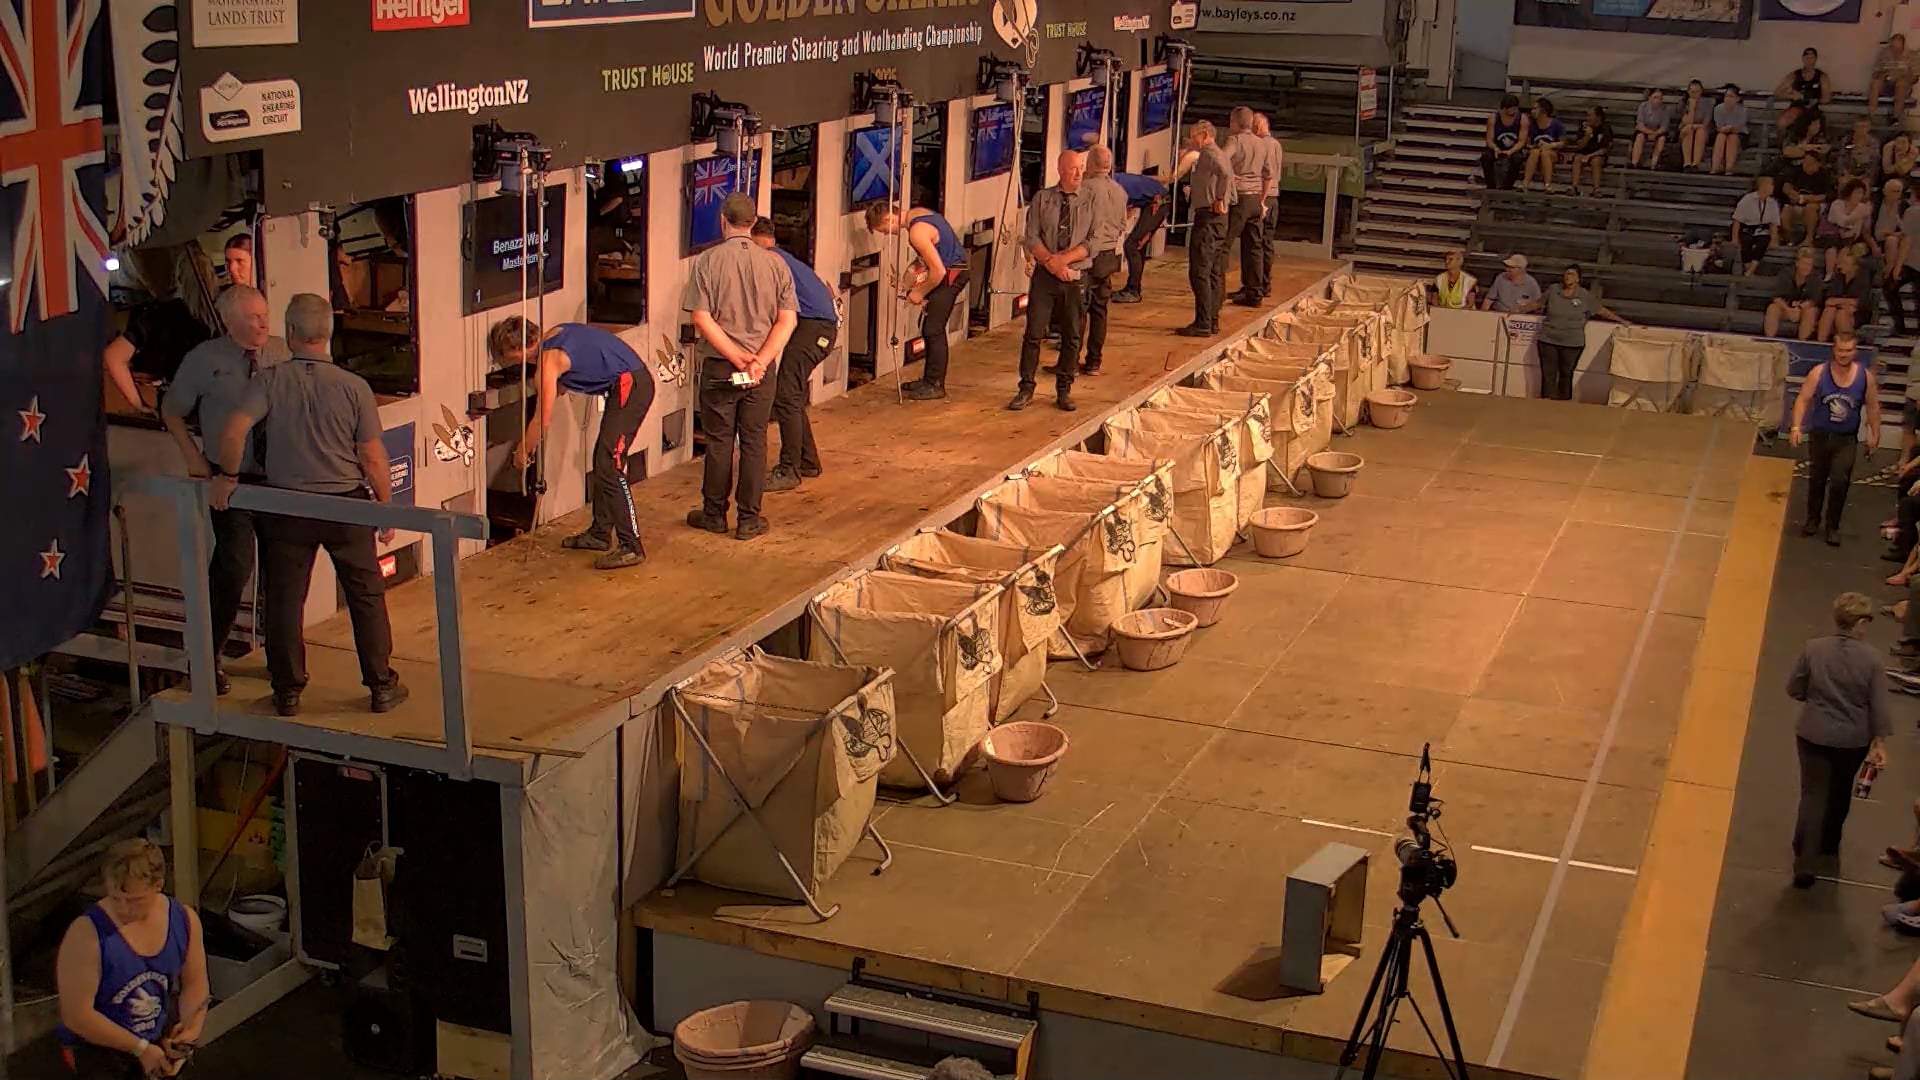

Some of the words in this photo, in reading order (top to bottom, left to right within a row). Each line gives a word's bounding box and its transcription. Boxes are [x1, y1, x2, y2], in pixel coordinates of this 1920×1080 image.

[208, 11, 247, 26] LANDS
[250, 10, 286, 25] TRUST
[703, 43, 739, 72] World
[744, 40, 788, 68] Premier
[791, 35, 839, 62] Shearing
[841, 31, 860, 56] and
[862, 26, 923, 52] Woolhandling
[926, 20, 982, 49] Championship
[601, 66, 648, 91] TRUST
[408, 79, 529, 115] WellingtonNZ
[493, 238, 525, 255] Benazz
[527, 228, 549, 247] Wad
